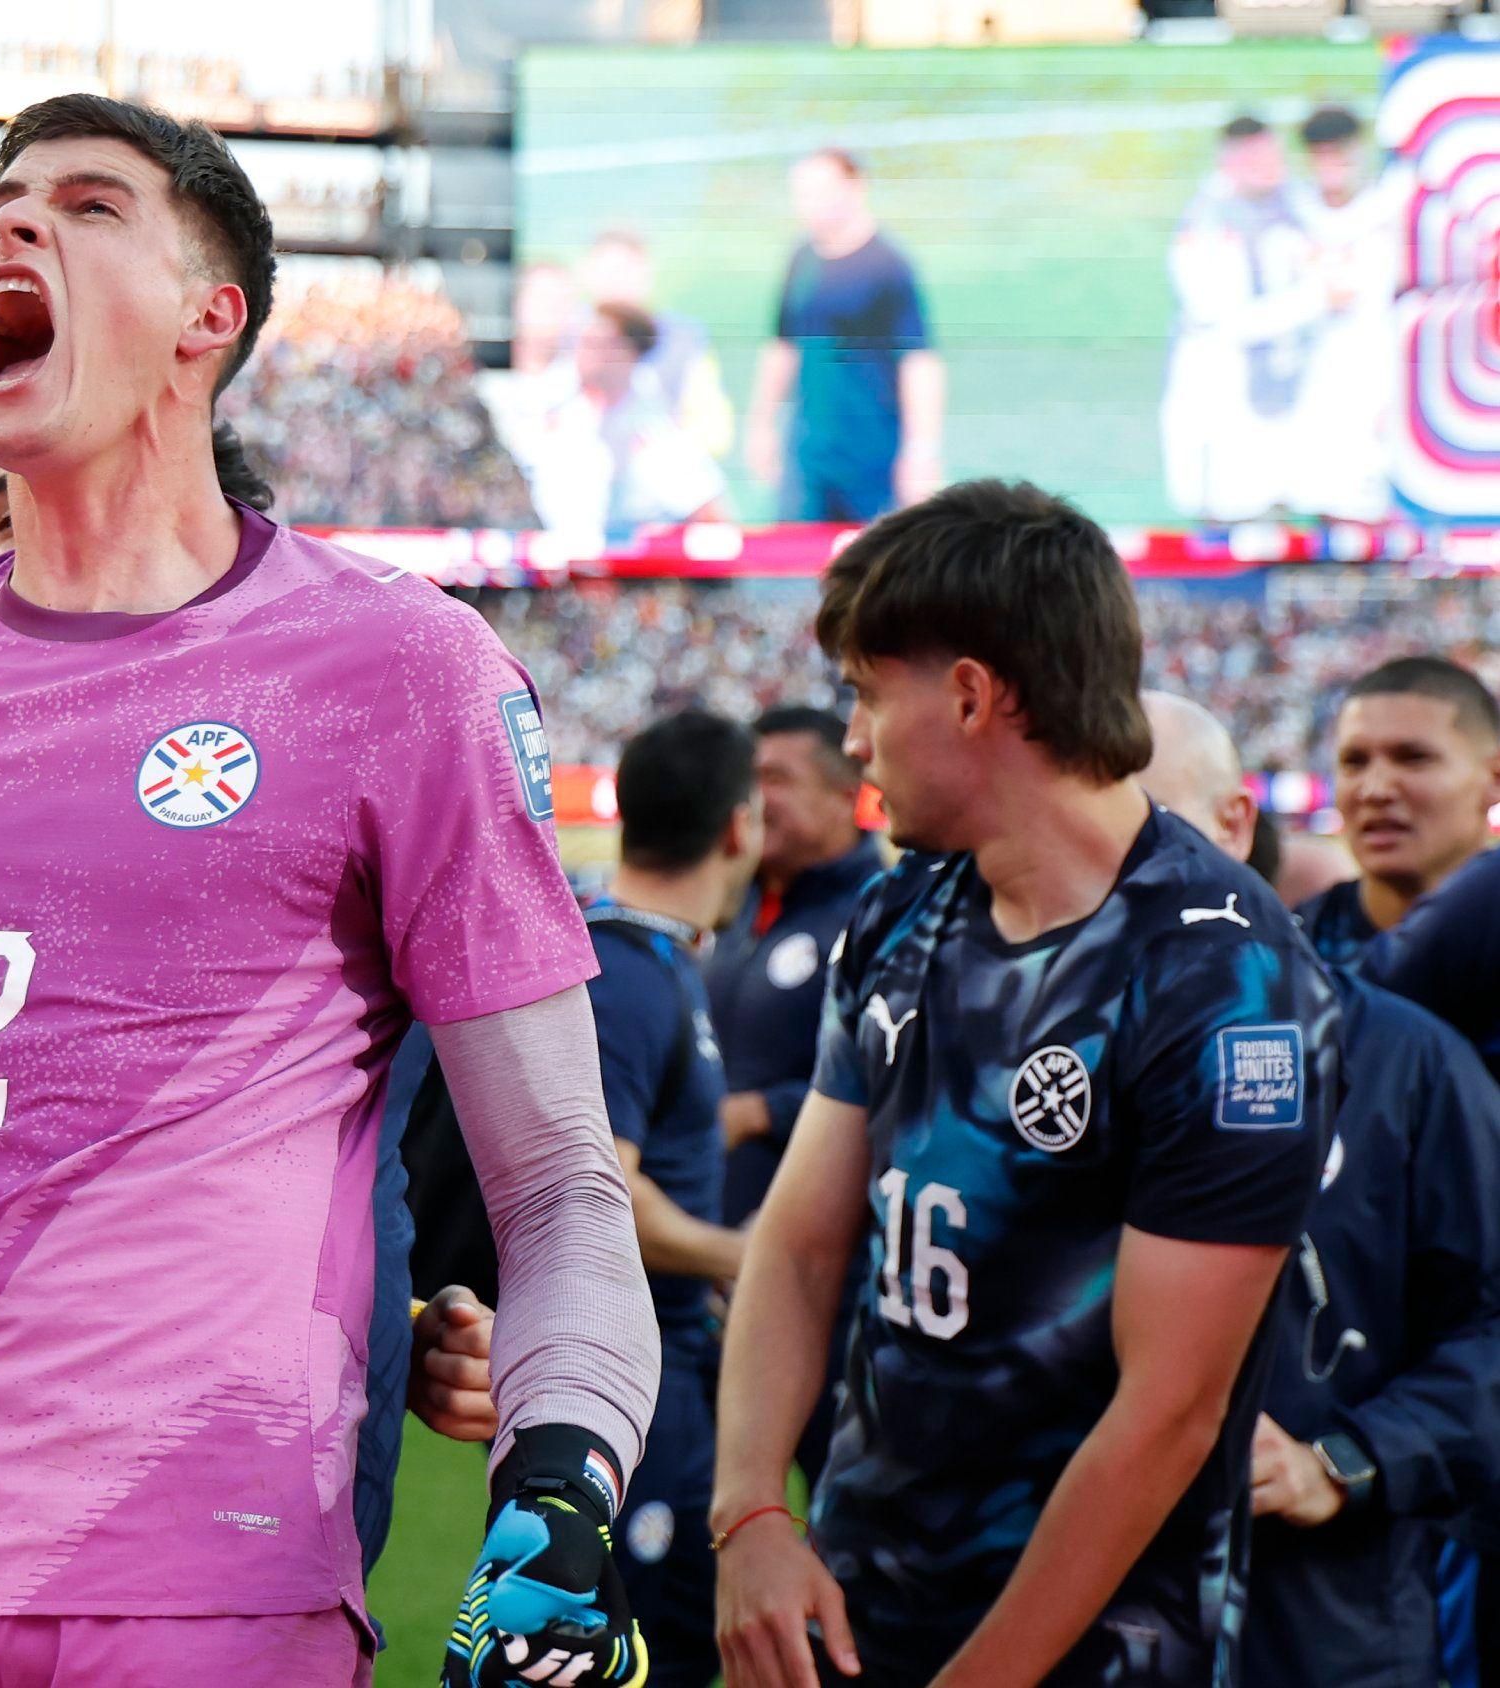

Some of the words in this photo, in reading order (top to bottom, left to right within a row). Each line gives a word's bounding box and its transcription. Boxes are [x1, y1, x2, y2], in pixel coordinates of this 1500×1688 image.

[185, 730, 228, 747] APF
[157, 806, 213, 823] PARAGUAY
[1232, 1040, 1292, 1057] FOOTBALL
[1045, 1053, 1073, 1075] APF
[1234, 1057, 1294, 1082] UNITES
[877, 1167, 969, 1341] 16
[213, 1510, 281, 1529] ULTRAWEAVE
